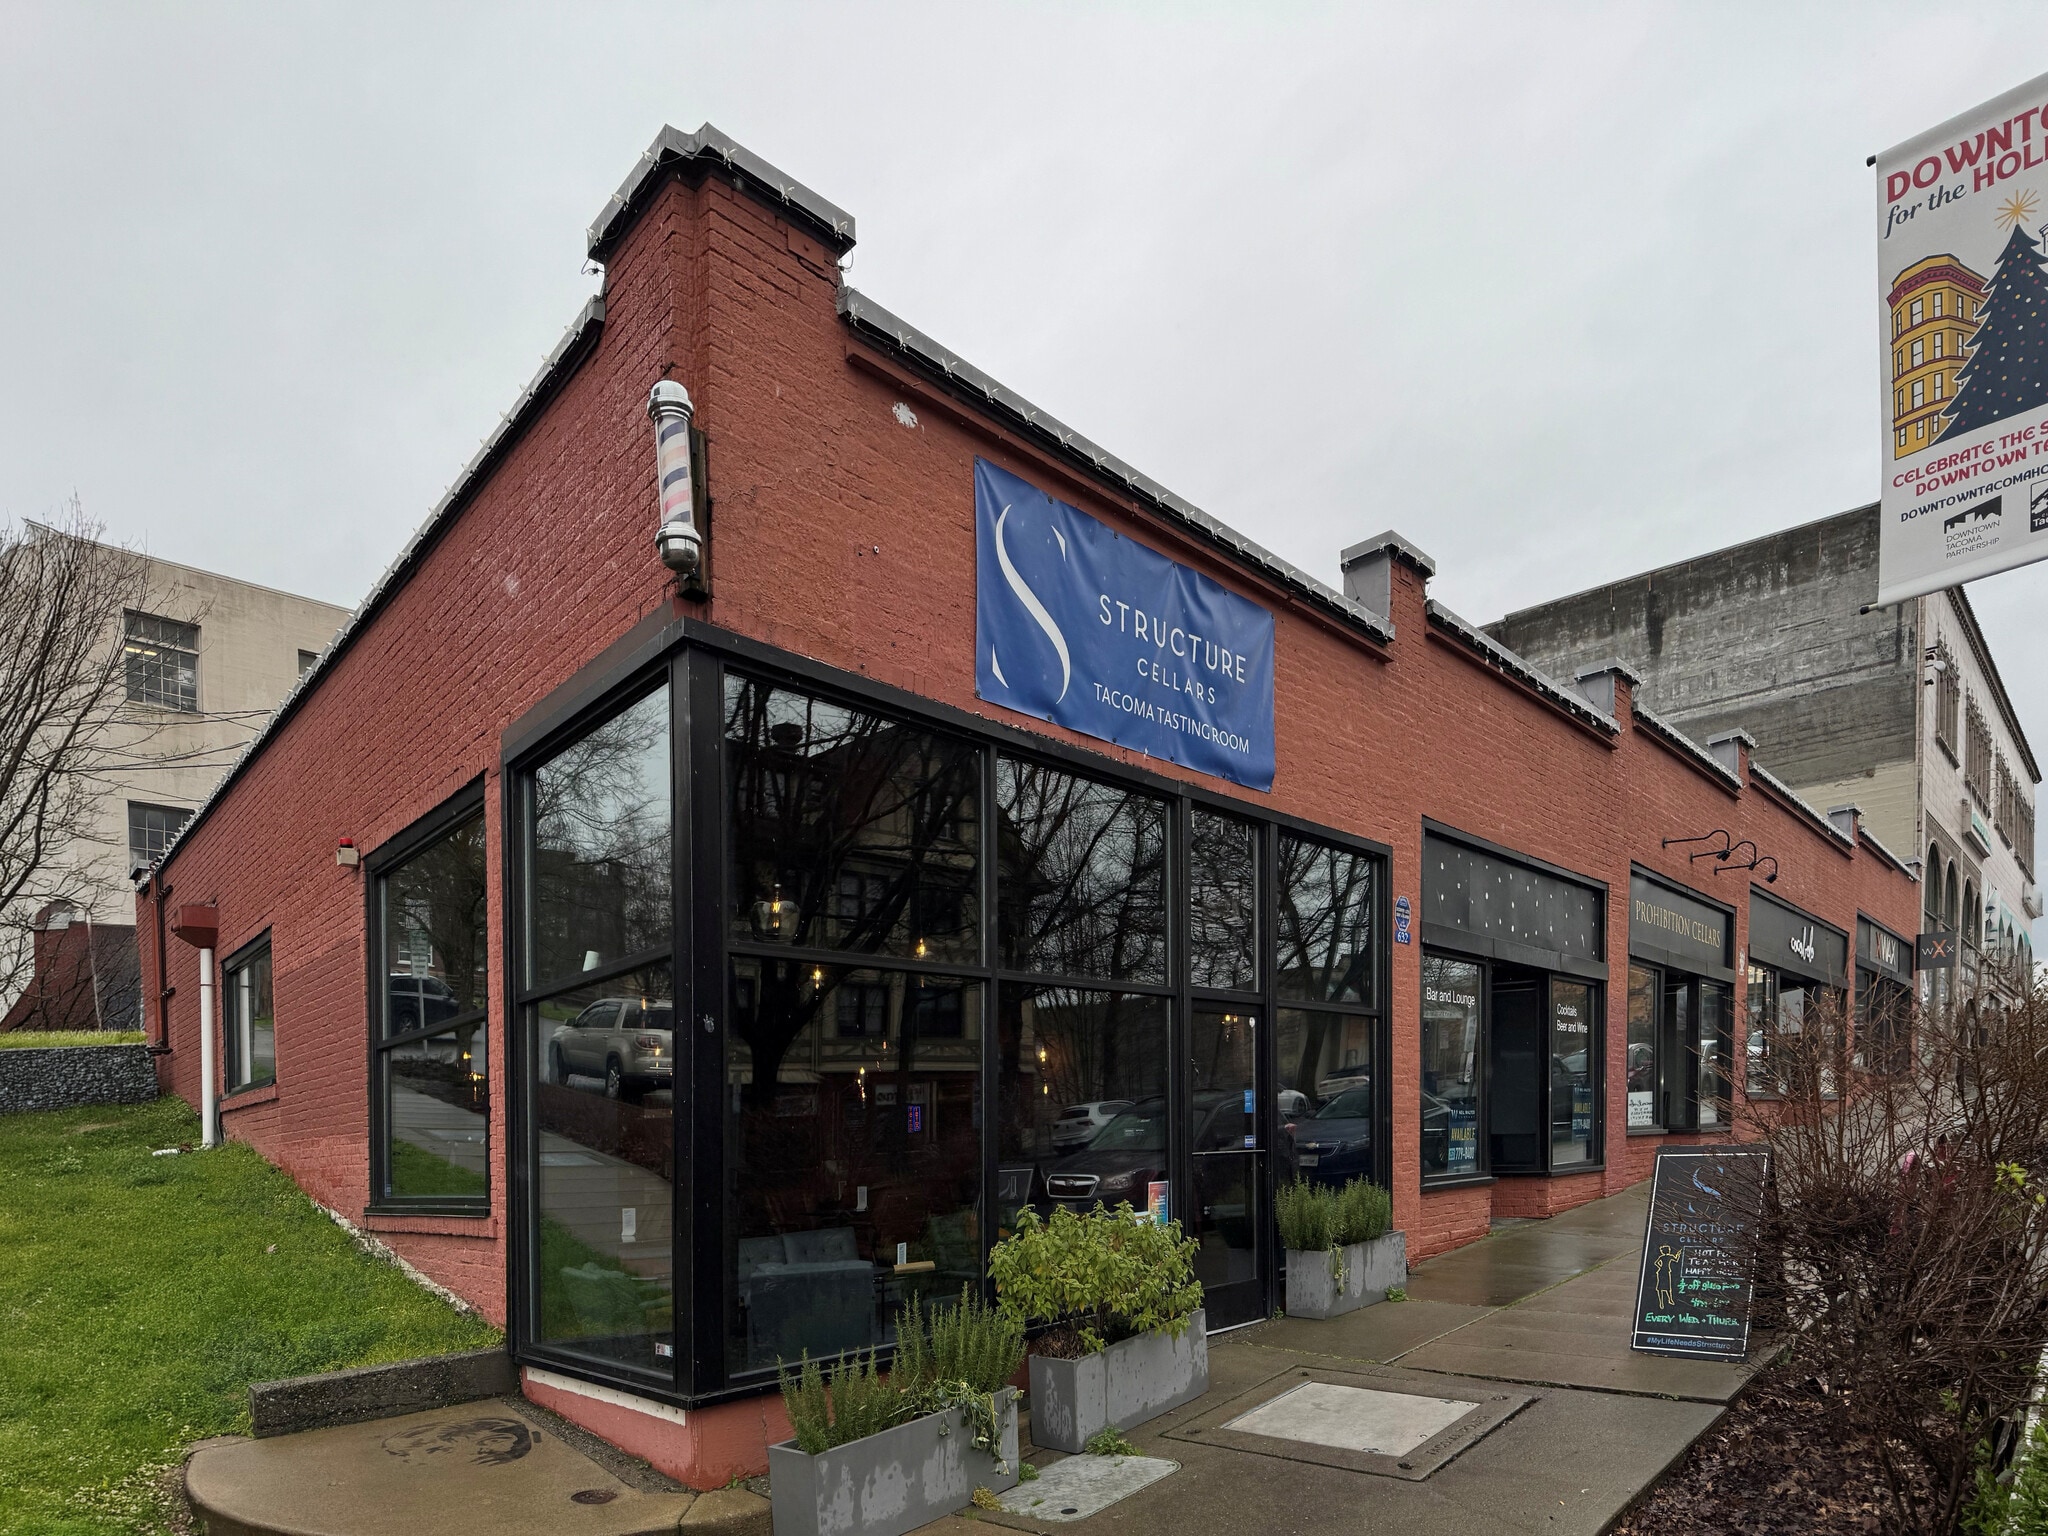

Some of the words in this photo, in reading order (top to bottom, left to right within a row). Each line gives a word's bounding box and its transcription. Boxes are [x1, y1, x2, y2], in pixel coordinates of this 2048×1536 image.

[1887, 103, 2048, 204] DOWNT
[1884, 202, 1922, 240] for
[1928, 184, 1967, 211] the
[1893, 440, 1995, 488] CELEBRATE
[1999, 426, 2035, 449] THE
[1916, 446, 2027, 497] DOWNTOWN
[1946, 520, 2000, 543] DOWNTOWN
[1946, 534, 1982, 551] TACOMA
[1946, 537, 2000, 559] PARTNERSHIP
[1099, 593, 1247, 685] STRUCTURE
[1137, 658, 1216, 705] CELLARS
[1093, 682, 1155, 722] TACOMA
[1635, 900, 1690, 937] PROHIBITION
[1691, 921, 1721, 948] CELLARS
[1397, 931, 1409, 943] 632
[1426, 987, 1438, 1001] Bar
[1439, 990, 1452, 1003] and
[1452, 990, 1476, 1009] Lounge
[1556, 1003, 1578, 1017] Cocktails
[1556, 1019, 1568, 1032] Beer
[1568, 1021, 1577, 1033] and
[1577, 1021, 1588, 1034] Wine
[1451, 1127, 1476, 1141] AVAILABLE
[1688, 1279, 1701, 1290] off
[1645, 1312, 1675, 1323] EVERY
